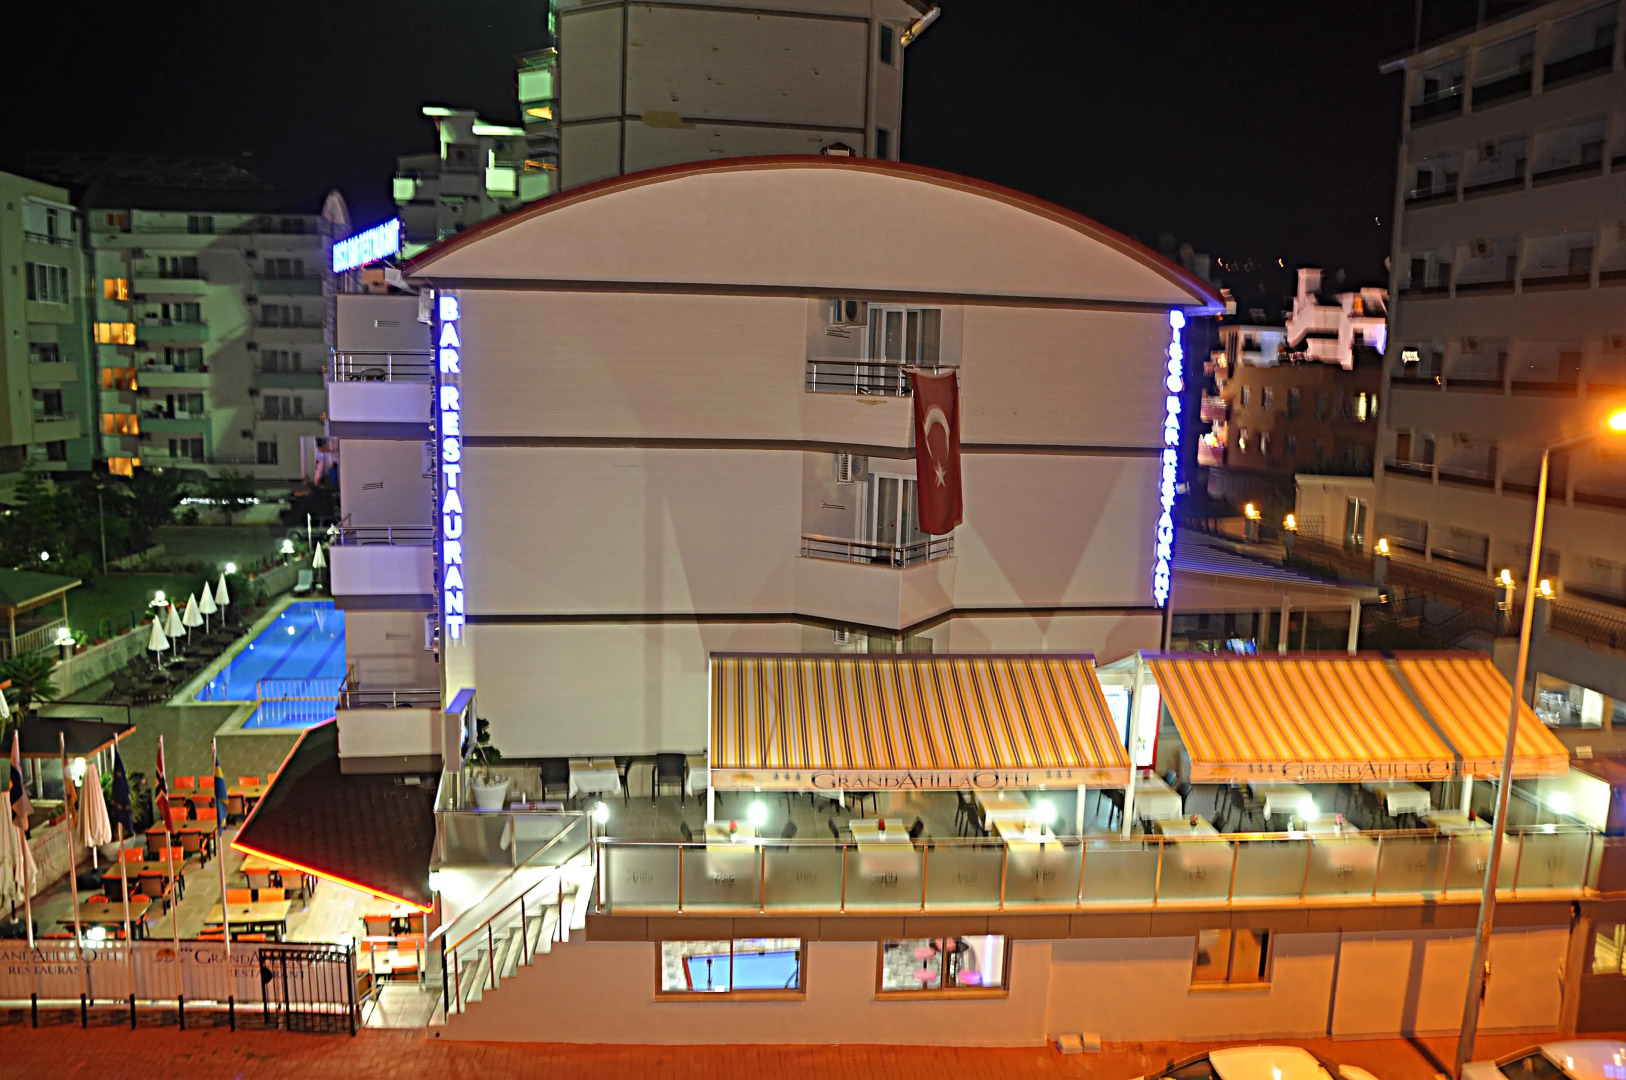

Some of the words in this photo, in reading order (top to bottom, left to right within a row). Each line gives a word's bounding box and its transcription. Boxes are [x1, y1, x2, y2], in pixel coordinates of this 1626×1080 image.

[439, 296, 461, 374] BAR
[1166, 309, 1186, 393] DISCO
[1163, 395, 1181, 446] BAR
[440, 386, 464, 639] RESTAURANT
[1153, 448, 1178, 609] RESTAURANT
